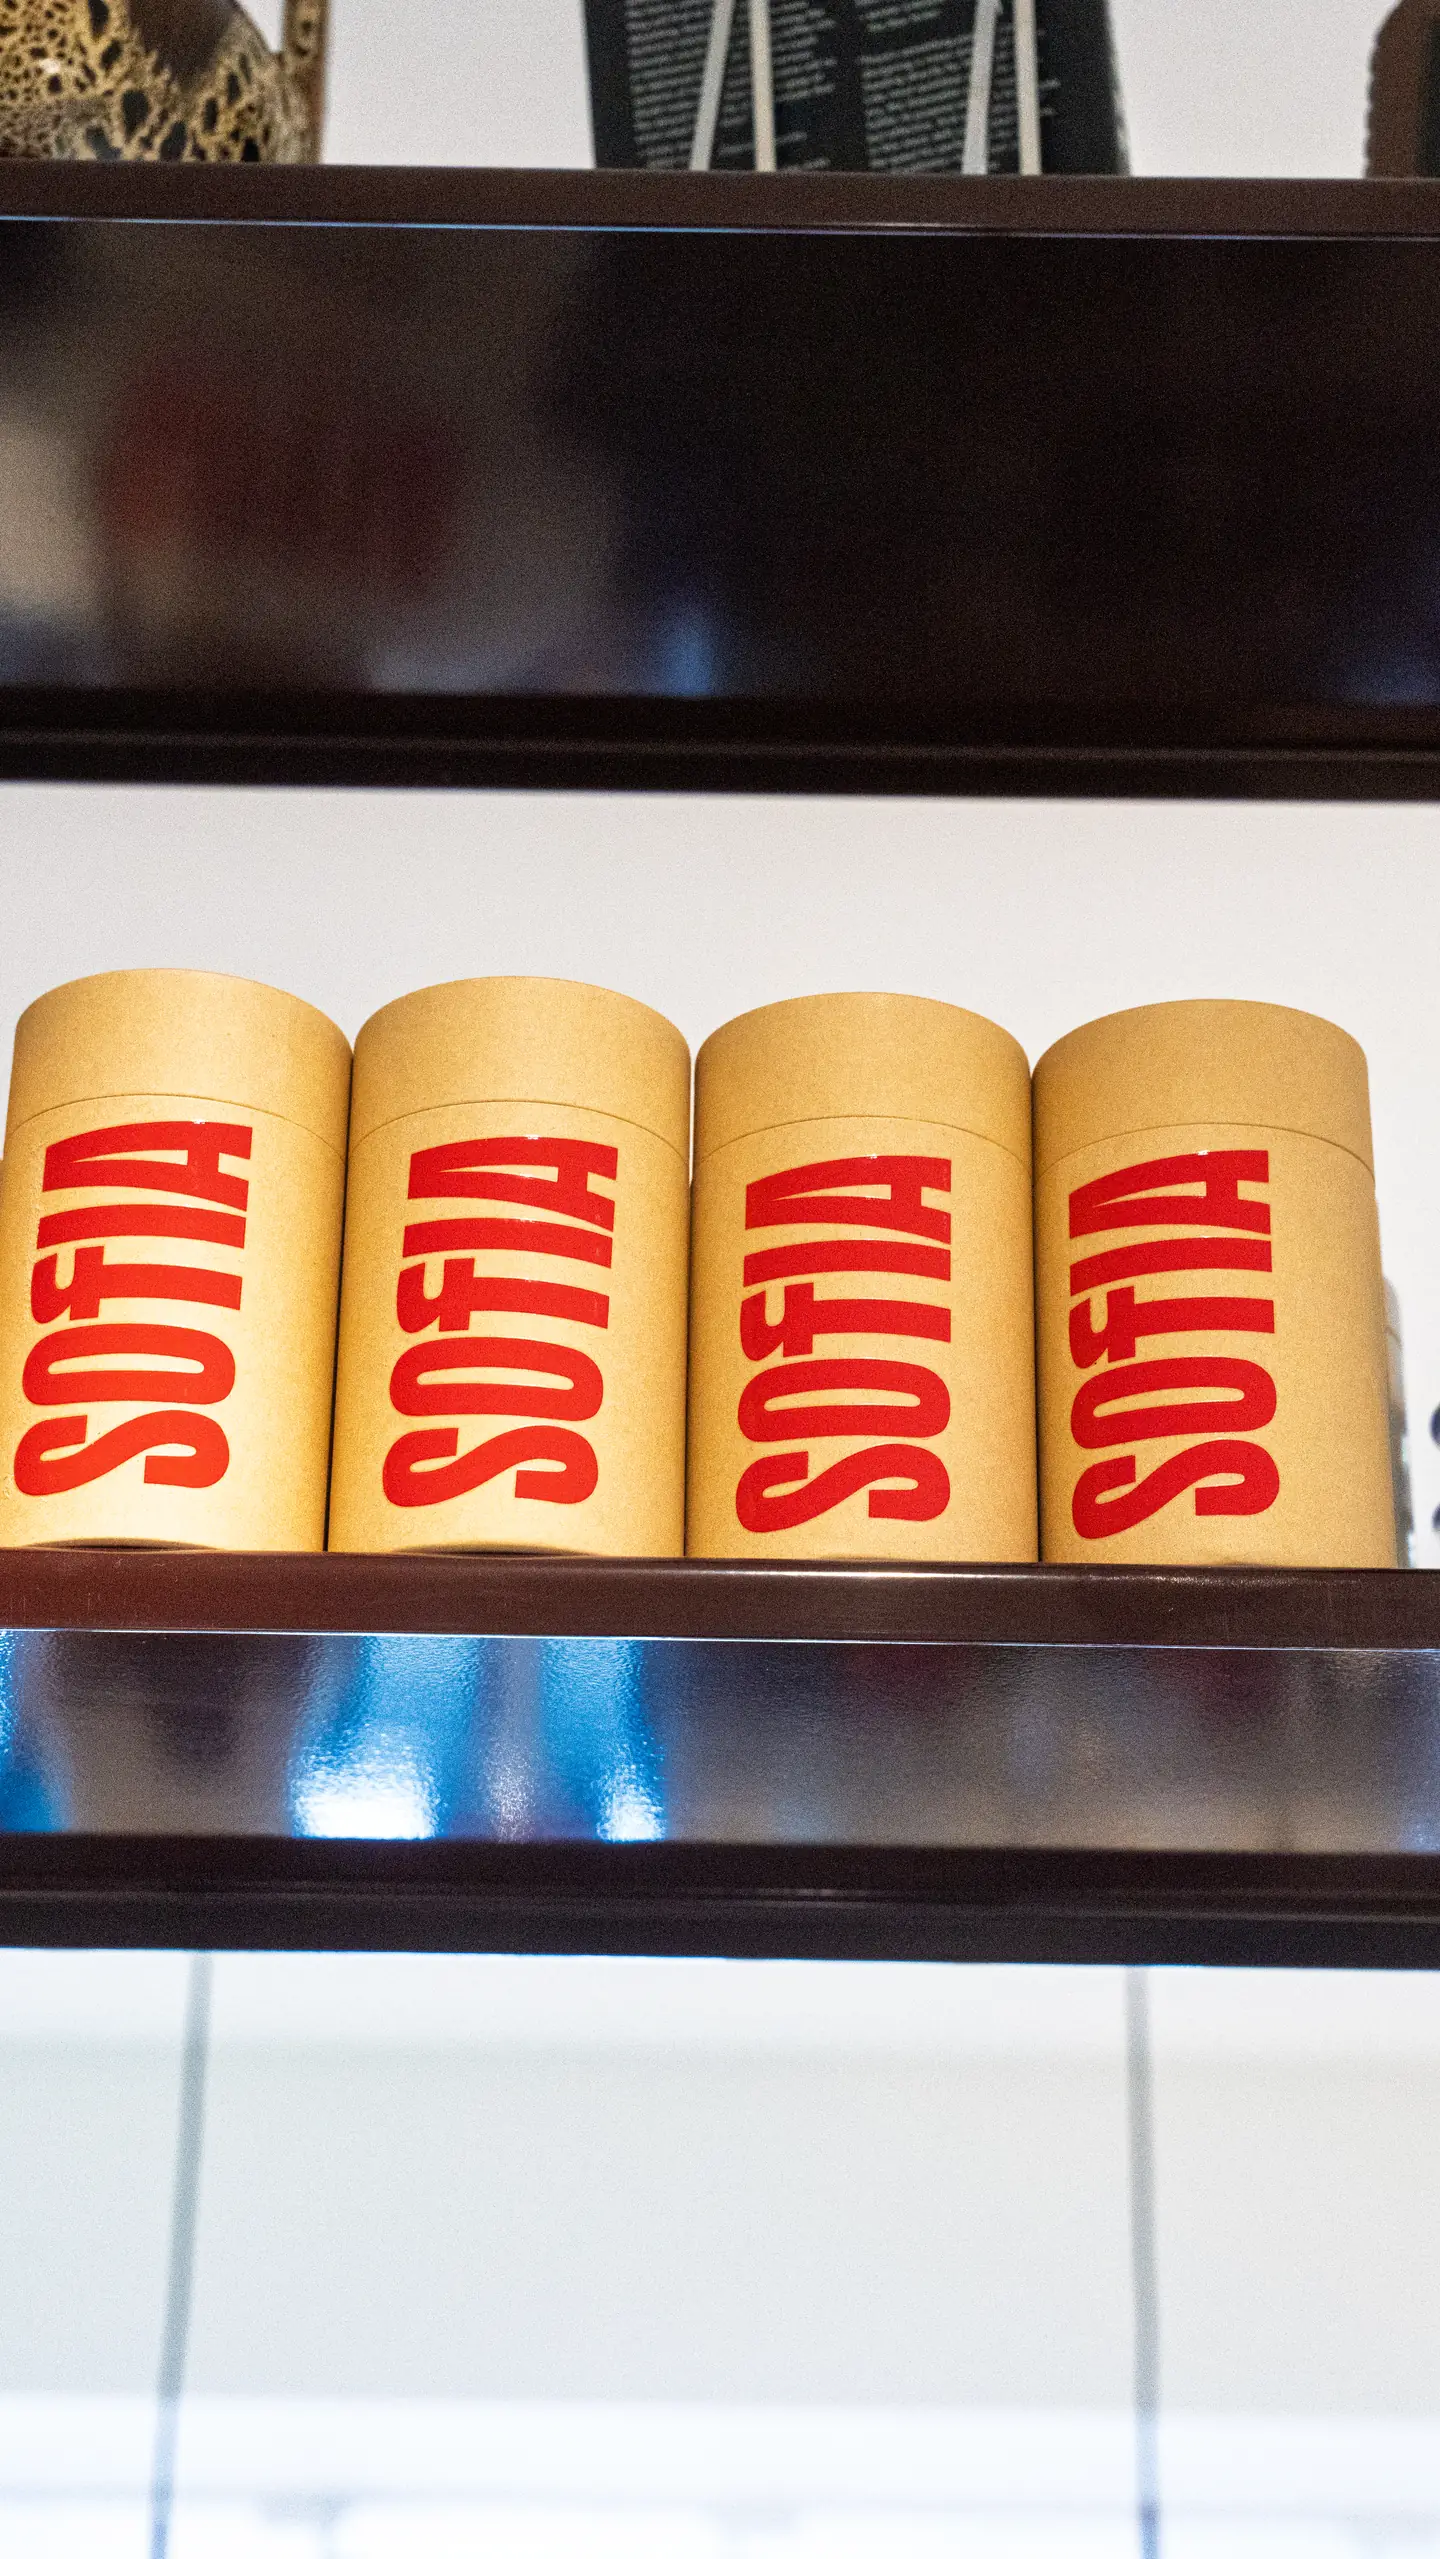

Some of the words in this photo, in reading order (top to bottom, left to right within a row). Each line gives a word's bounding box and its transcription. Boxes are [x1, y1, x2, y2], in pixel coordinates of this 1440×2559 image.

[14, 1120, 254, 1498] SOFIA
[383, 1136, 618, 1508] SOFIA
[735, 1154, 952, 1534] SOFIA
[1070, 1149, 1280, 1540] SOFIA
